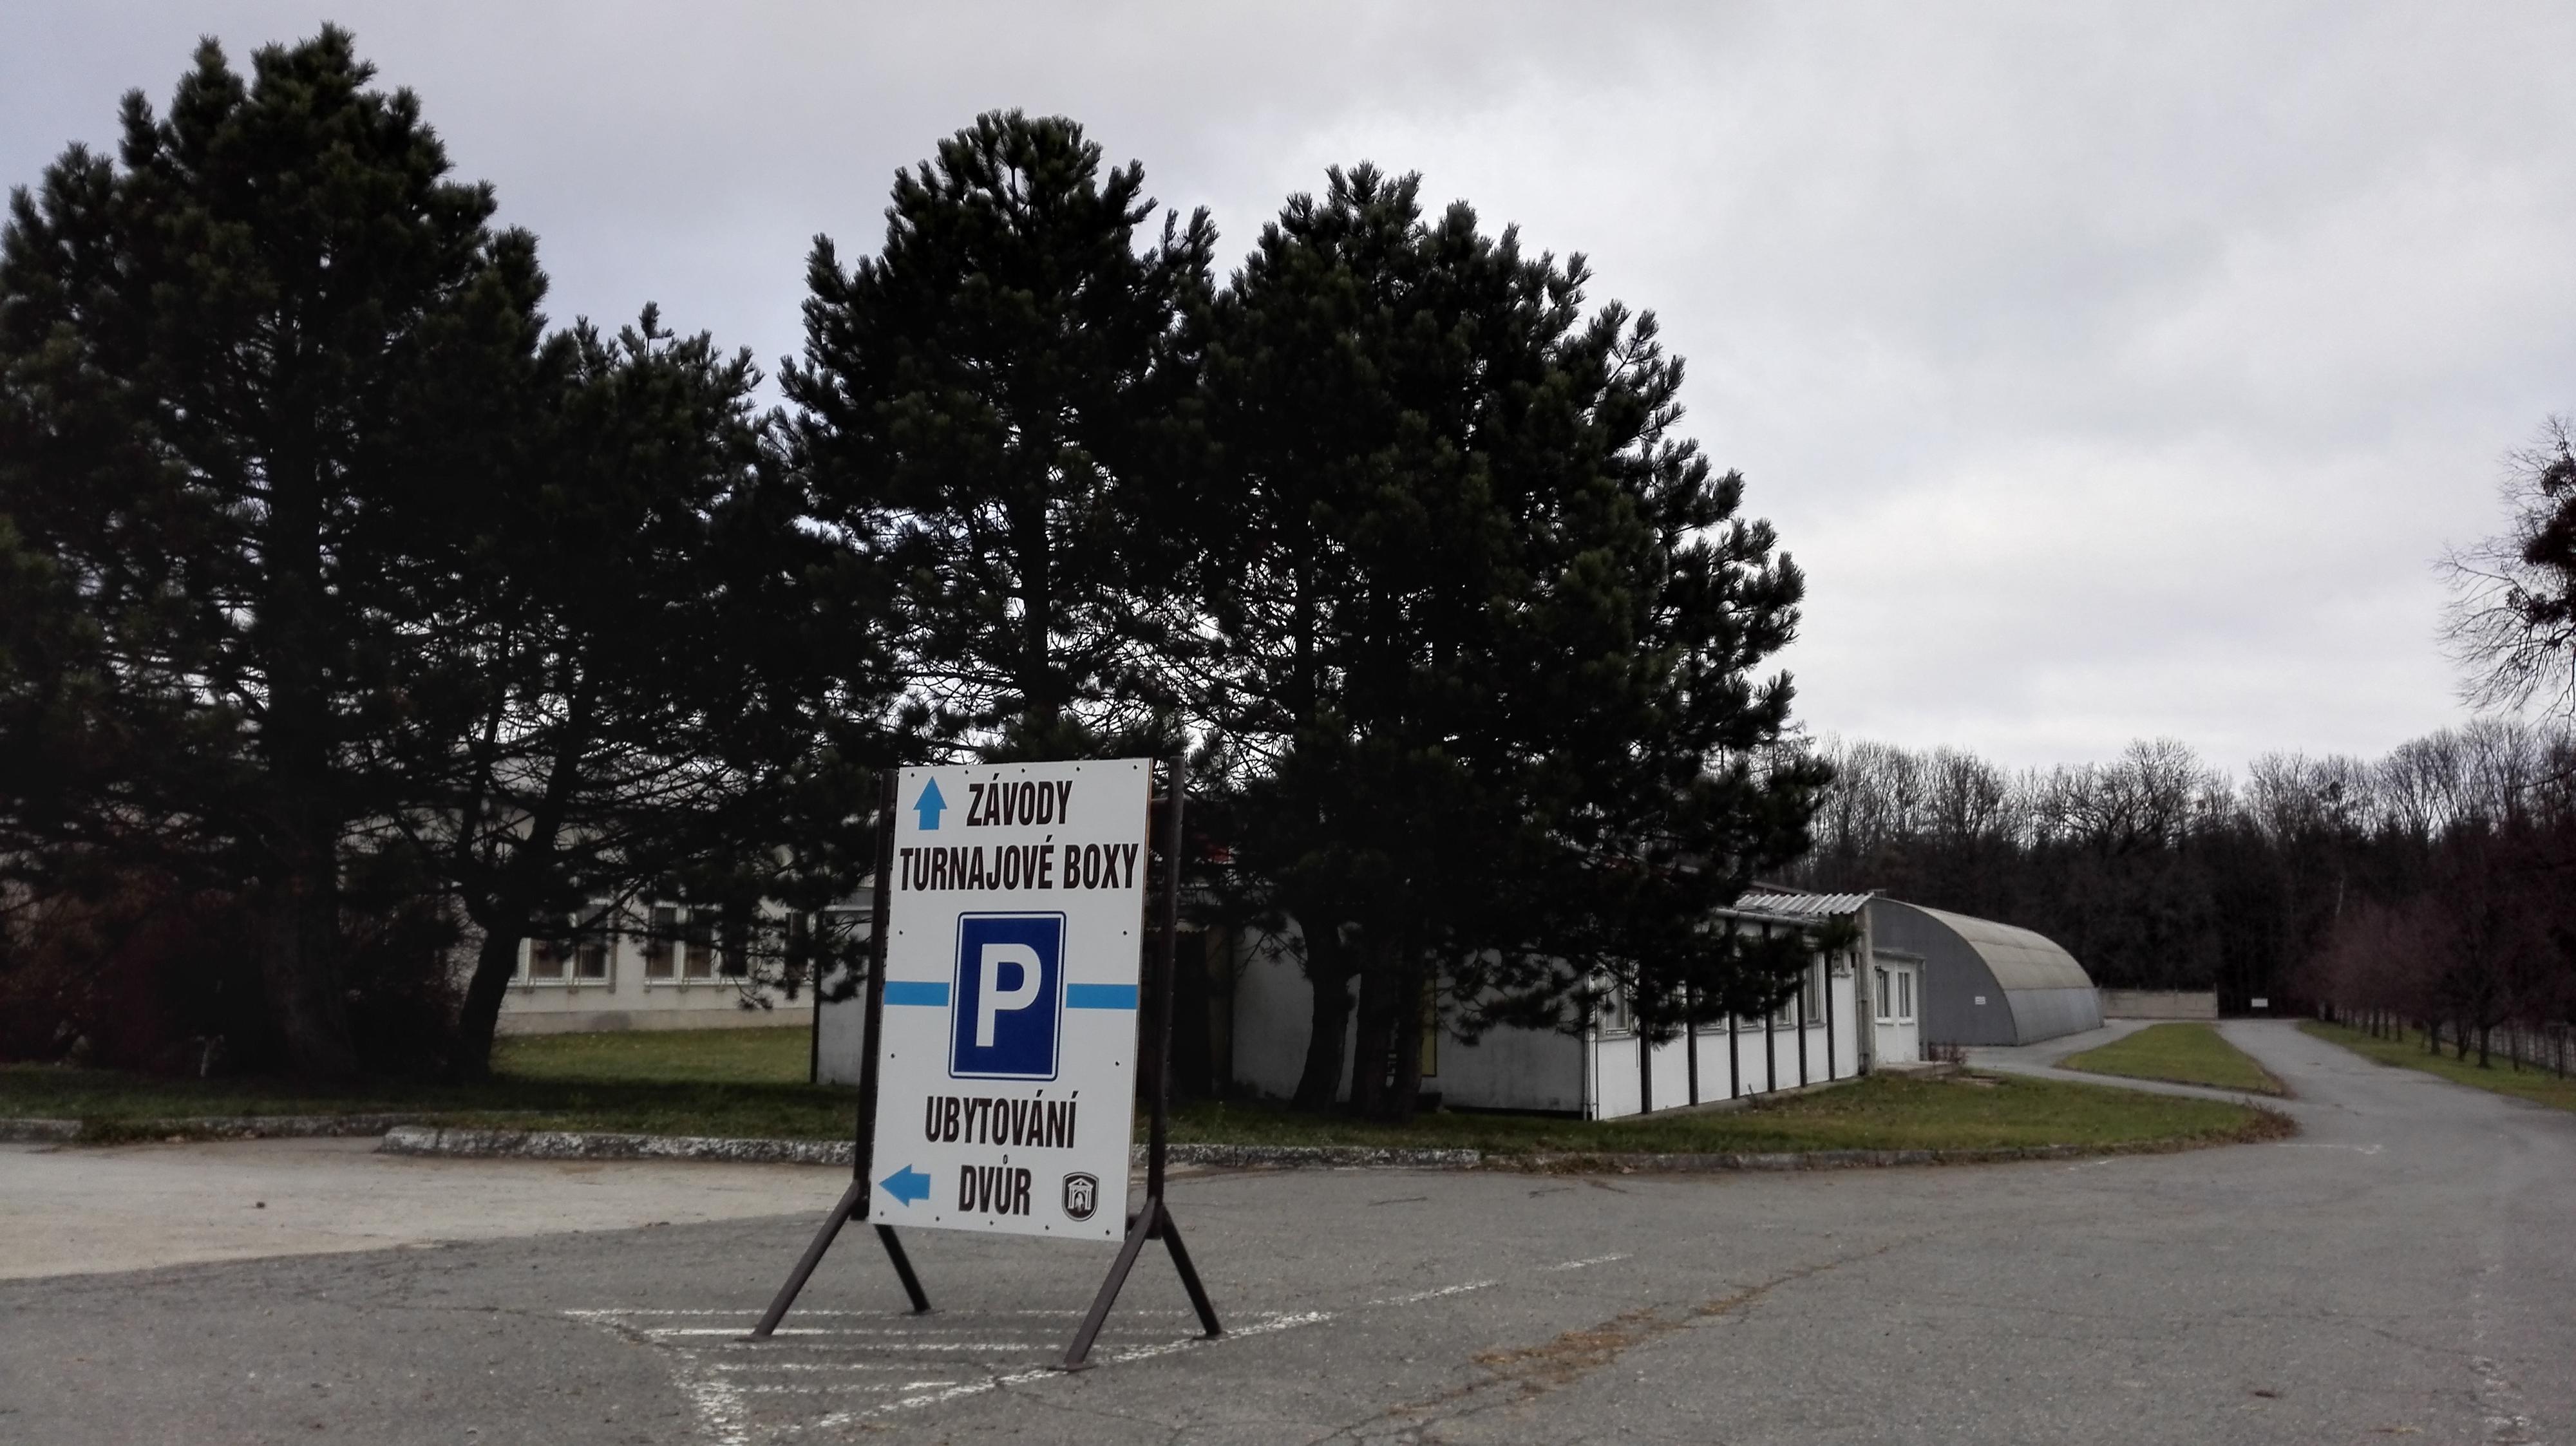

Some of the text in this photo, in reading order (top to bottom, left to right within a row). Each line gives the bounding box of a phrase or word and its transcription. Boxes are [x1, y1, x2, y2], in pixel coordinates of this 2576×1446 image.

[966, 773, 1073, 827] ZÁVODY
[899, 834, 1139, 892] TURNAJOVÉ BOXY
[976, 943, 1042, 1047] P
[925, 1089, 1079, 1149] UBYTOVÁNÍ
[958, 1154, 1032, 1216] DVŮR
